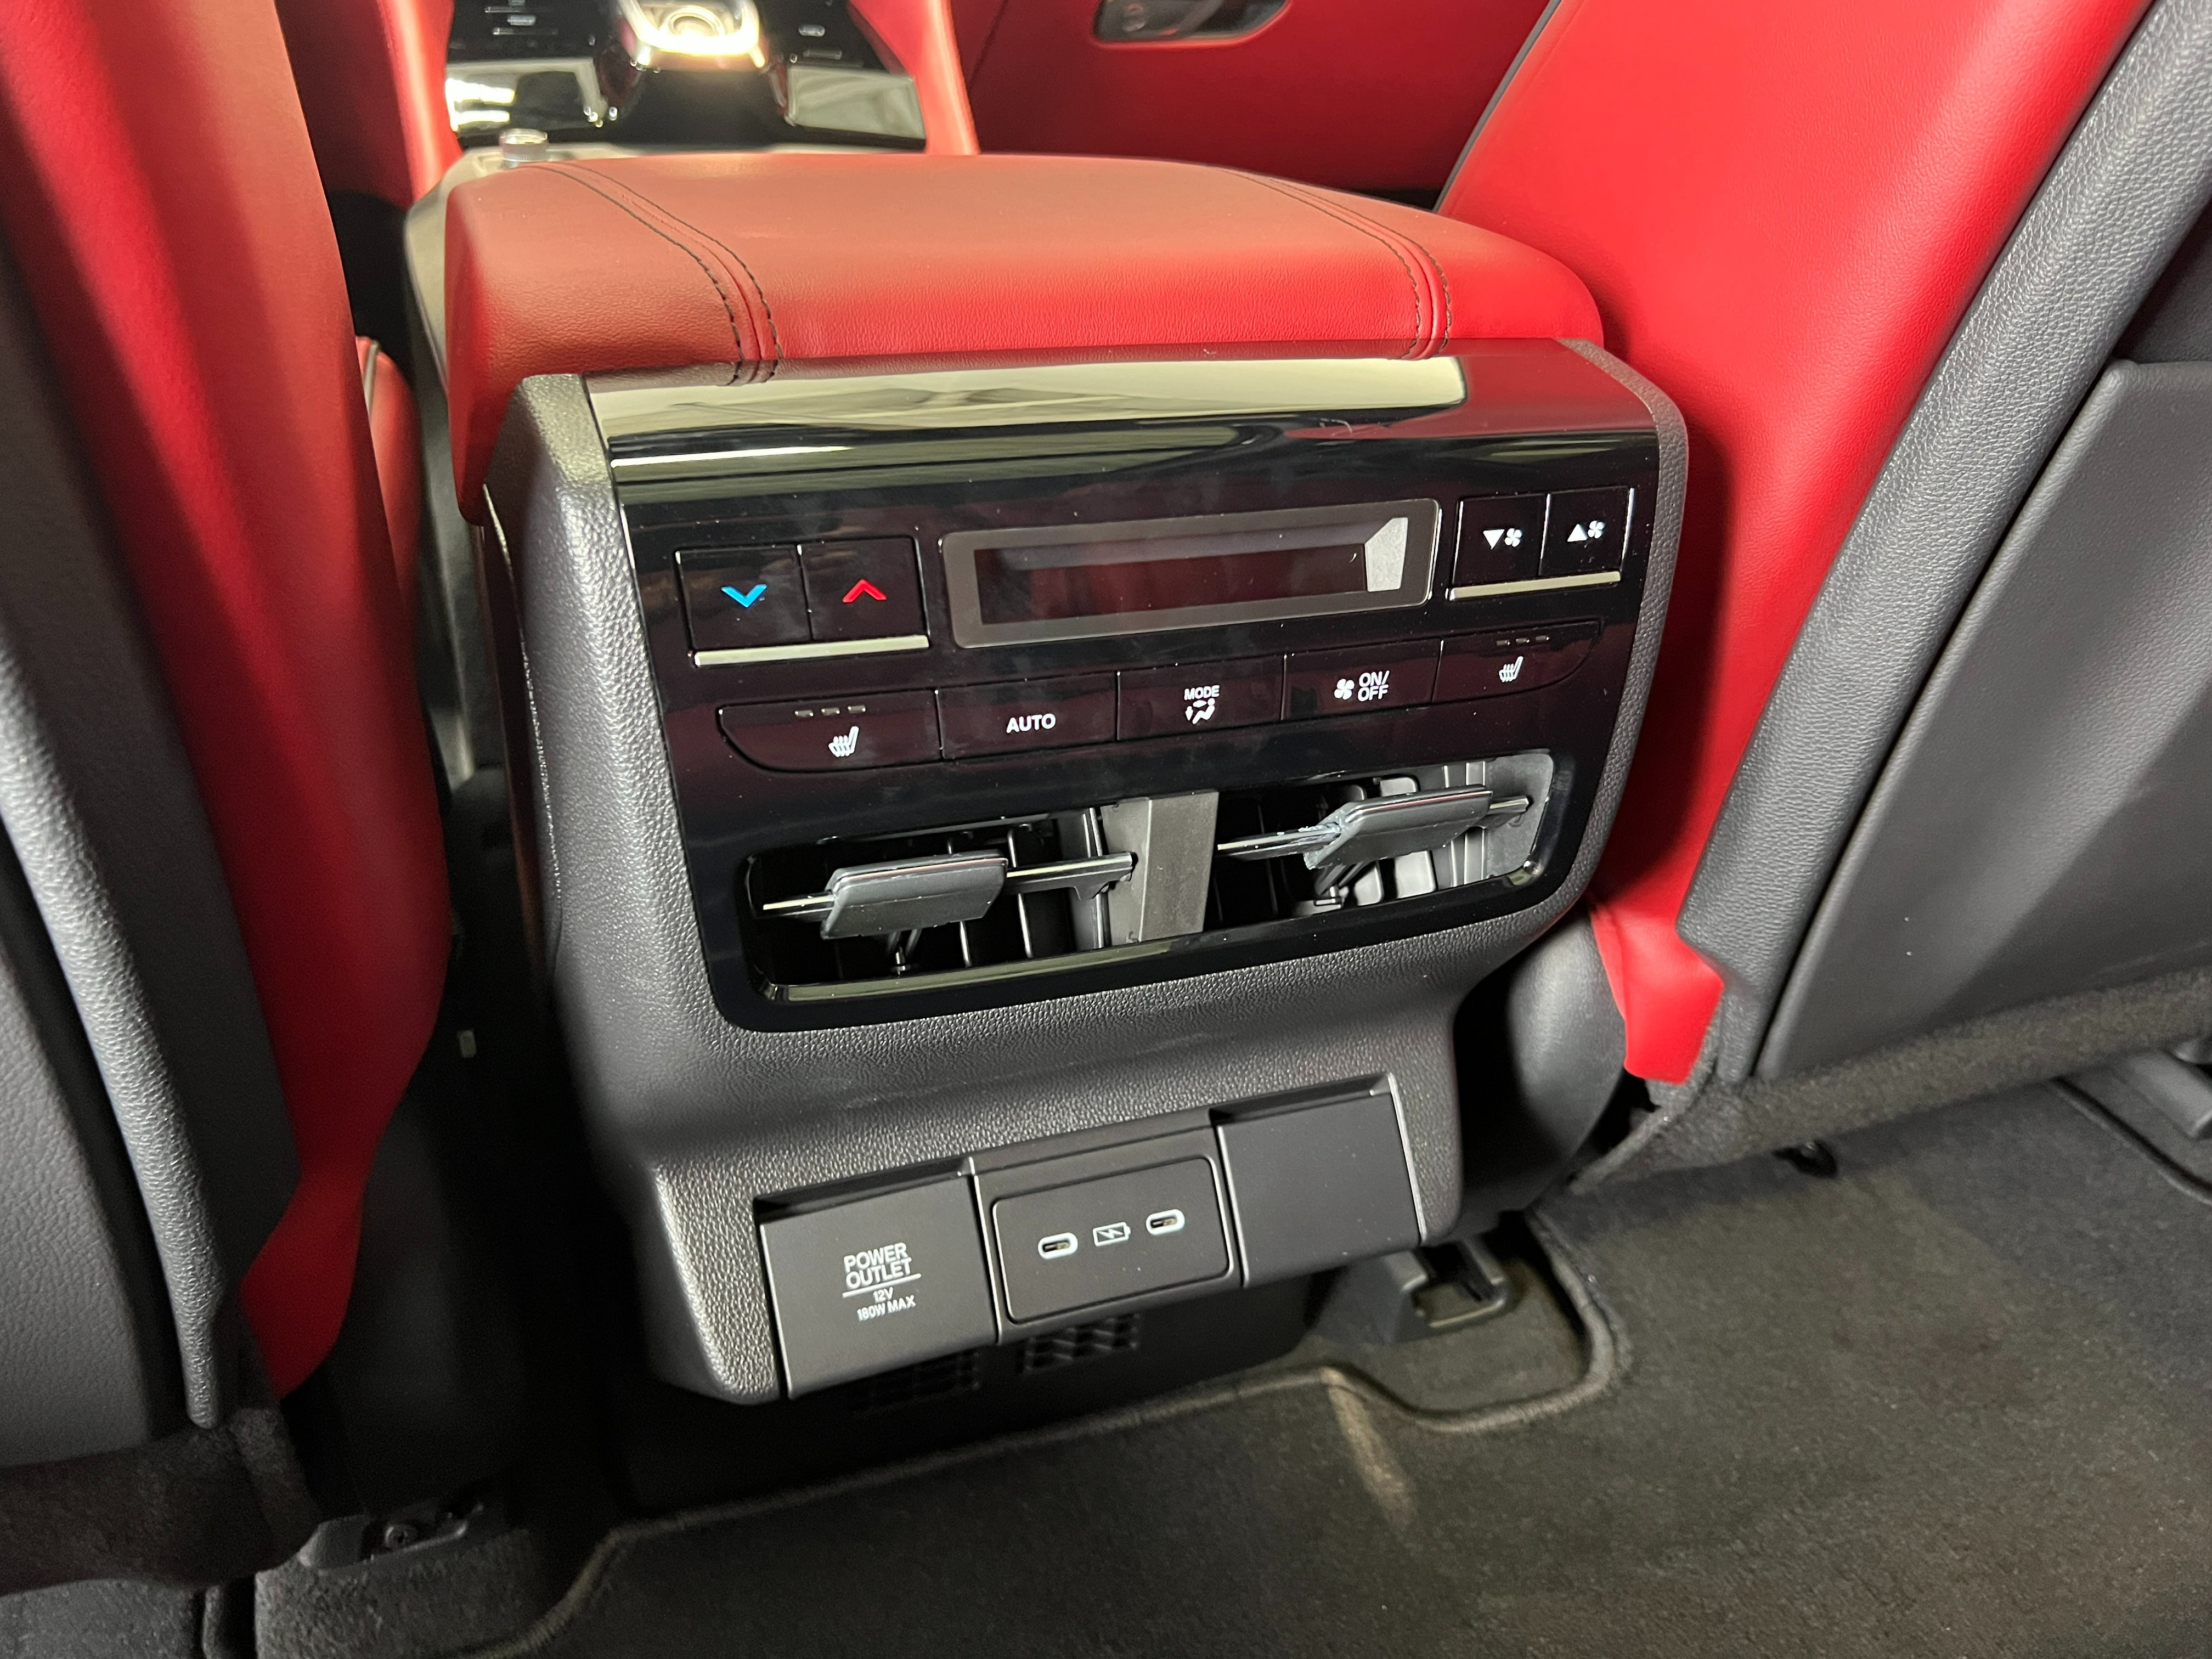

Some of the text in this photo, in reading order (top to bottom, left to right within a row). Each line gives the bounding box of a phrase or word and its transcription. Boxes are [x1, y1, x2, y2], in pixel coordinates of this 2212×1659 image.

[1359, 670, 1390, 687] ON/
[1184, 685, 1220, 700] MODE
[1358, 684, 1389, 702] OFF
[1006, 713, 1056, 733] AUTO
[843, 1242, 909, 1273] POWER
[845, 1257, 912, 1289] OUTLET
[873, 1286, 894, 1303] 12V
[857, 1295, 916, 1321] 180W MAX
